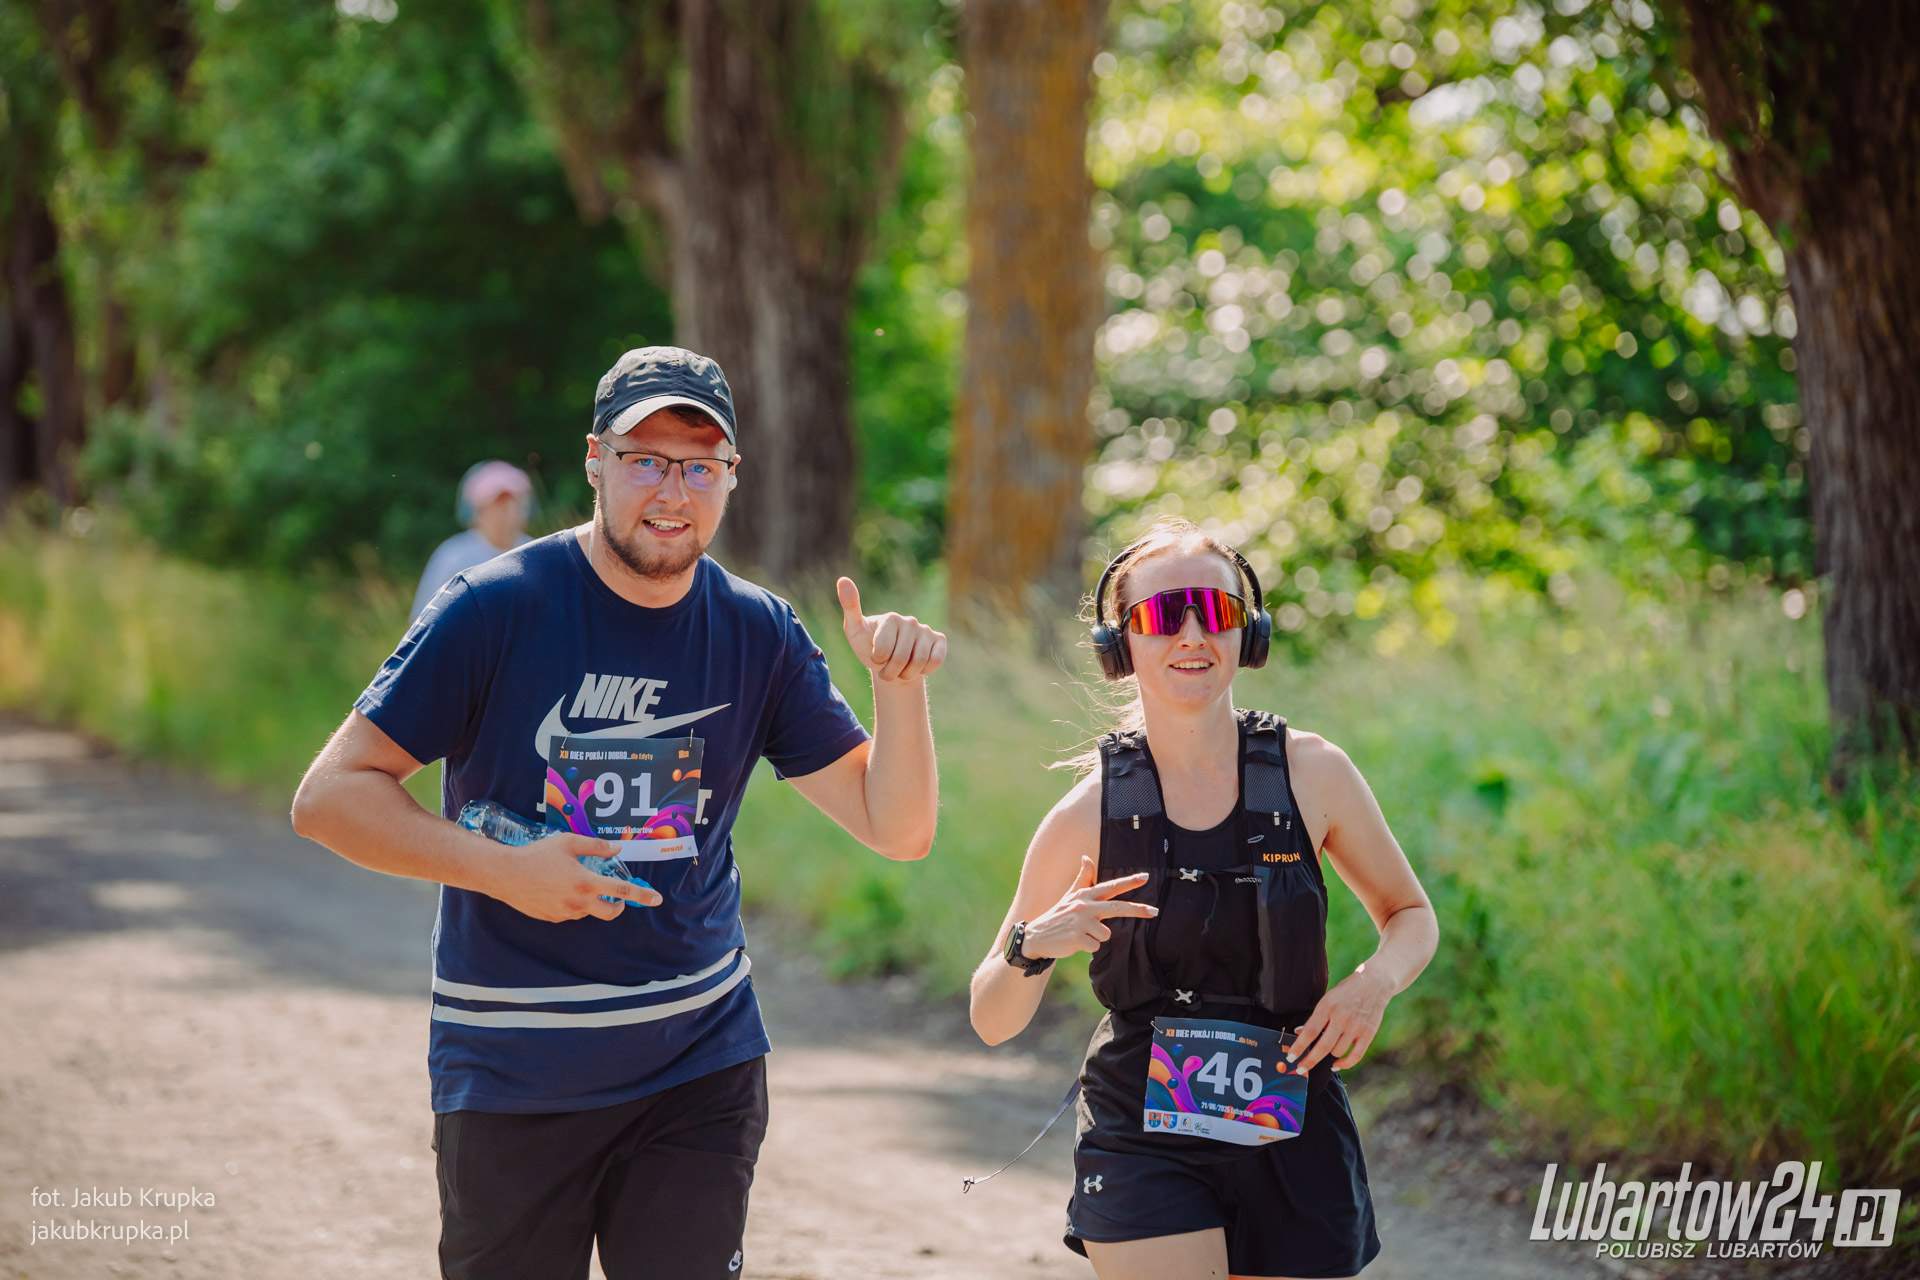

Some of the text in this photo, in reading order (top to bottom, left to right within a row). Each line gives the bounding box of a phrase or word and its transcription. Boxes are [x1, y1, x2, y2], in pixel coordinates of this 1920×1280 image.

[568, 672, 668, 722] NIKE
[595, 772, 658, 817] 91
[1263, 852, 1301, 862] KIPRUN
[1197, 1052, 1263, 1101] 46
